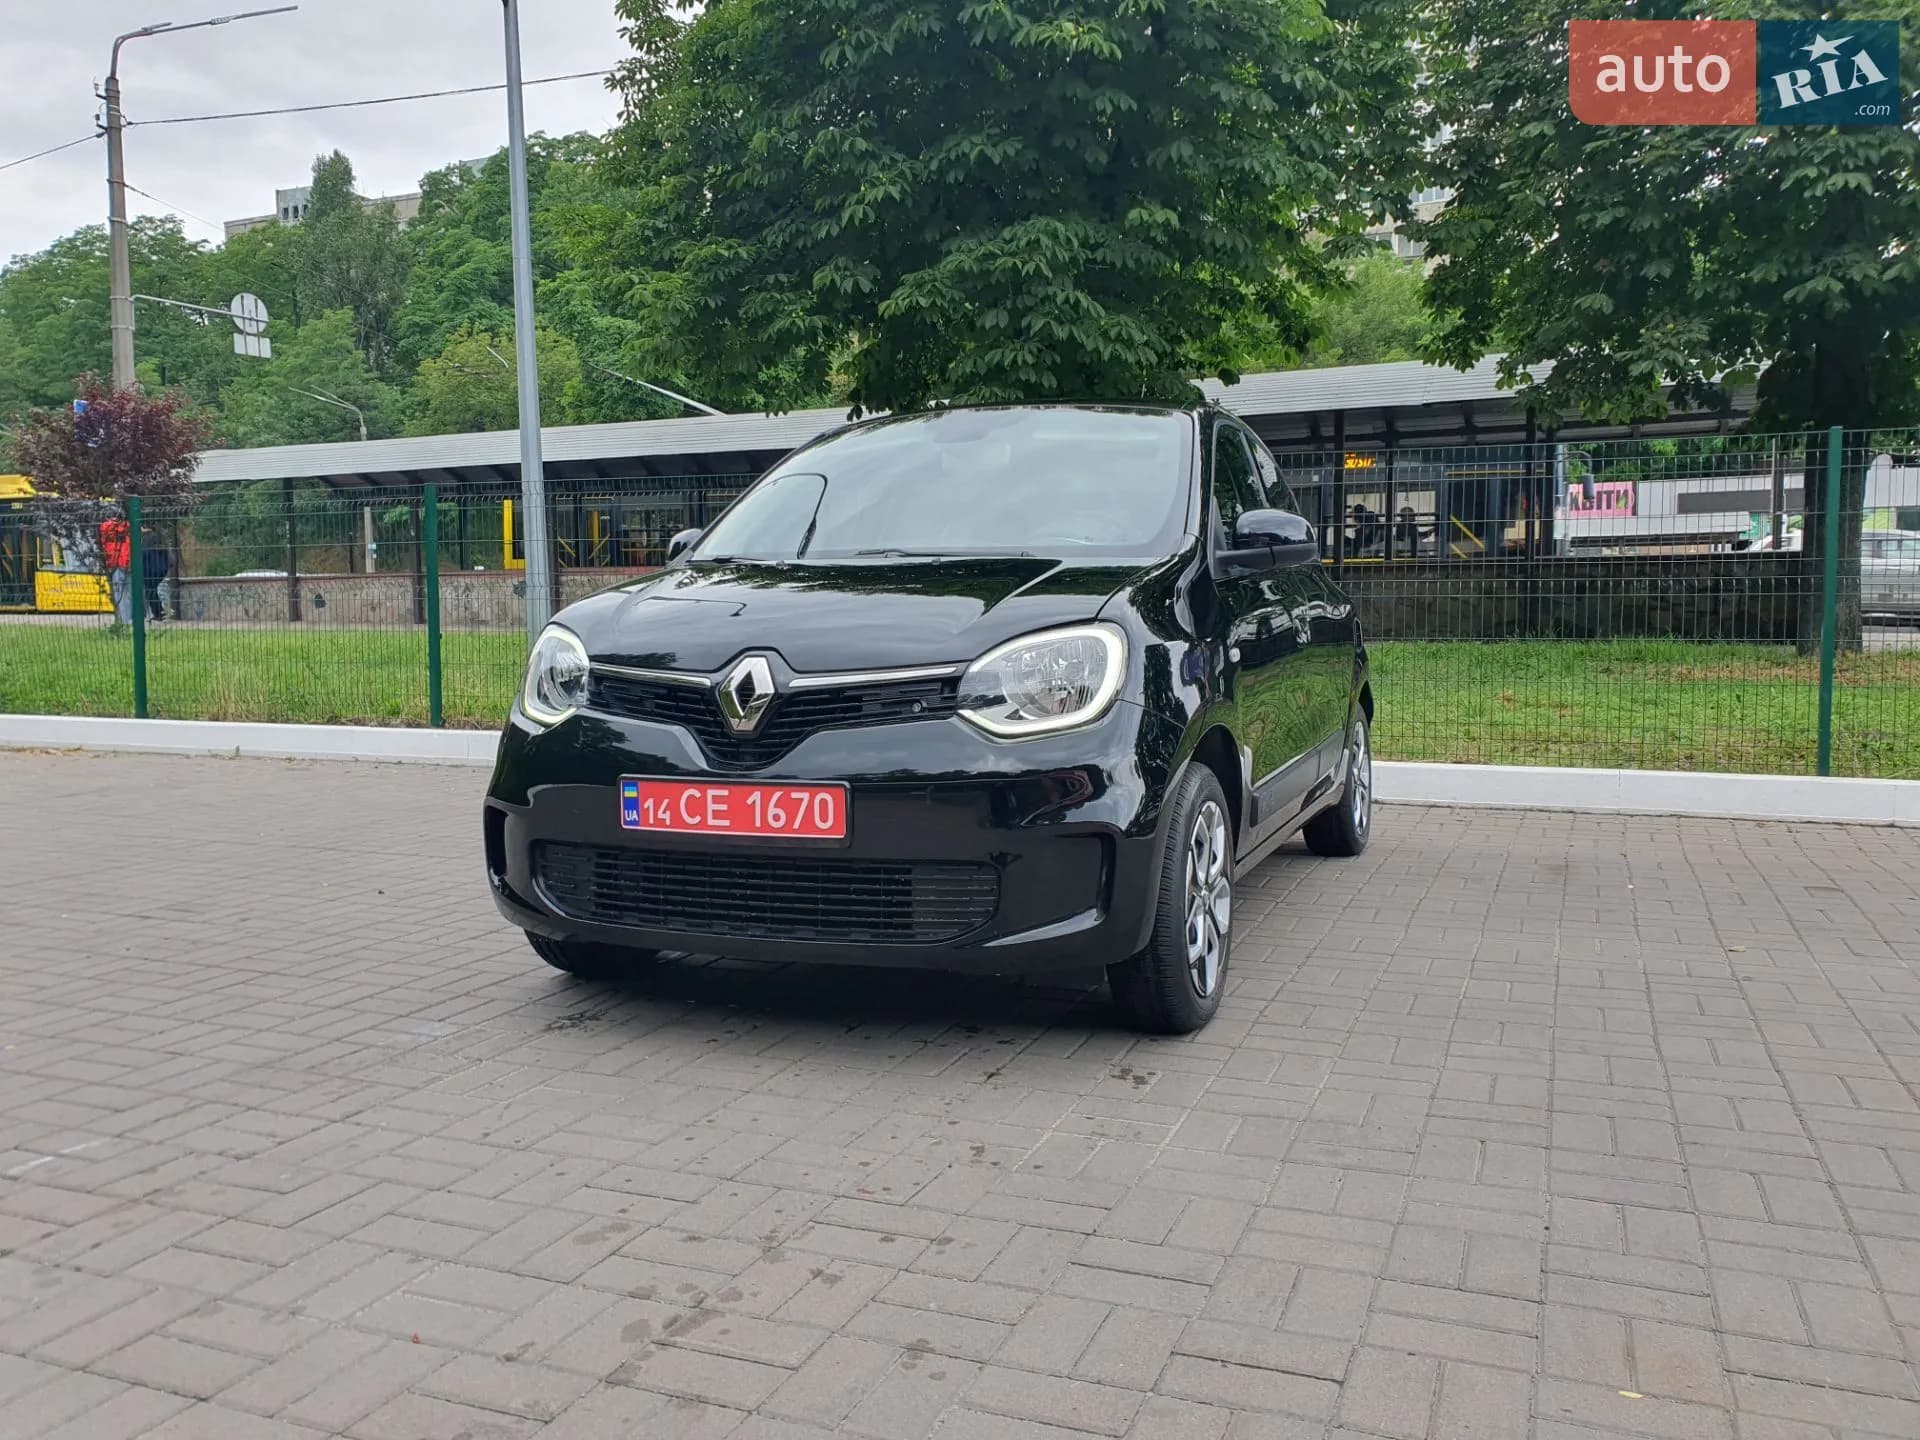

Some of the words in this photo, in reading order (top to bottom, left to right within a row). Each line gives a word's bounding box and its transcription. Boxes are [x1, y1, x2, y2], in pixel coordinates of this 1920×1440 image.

[624, 809, 639, 822] UA
[643, 798, 671, 825] 14
[679, 788, 731, 827] CE
[746, 790, 835, 830] 1670
